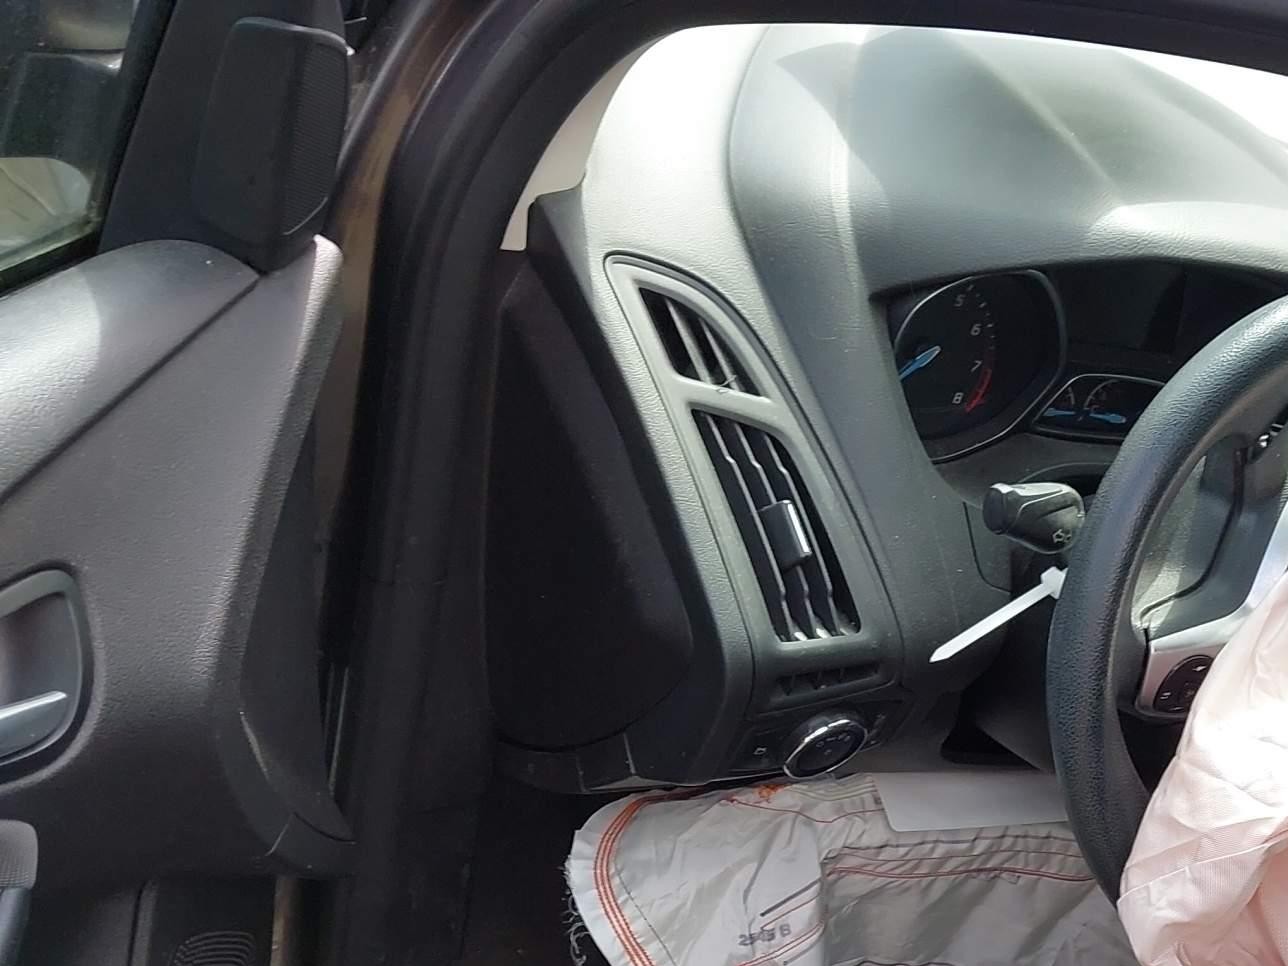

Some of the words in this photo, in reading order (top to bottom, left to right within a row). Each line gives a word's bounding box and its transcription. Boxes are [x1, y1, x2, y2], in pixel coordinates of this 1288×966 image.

[954, 294, 967, 307] 5
[970, 323, 982, 336] 6
[970, 360, 983, 372] 7
[952, 392, 964, 405] 8
